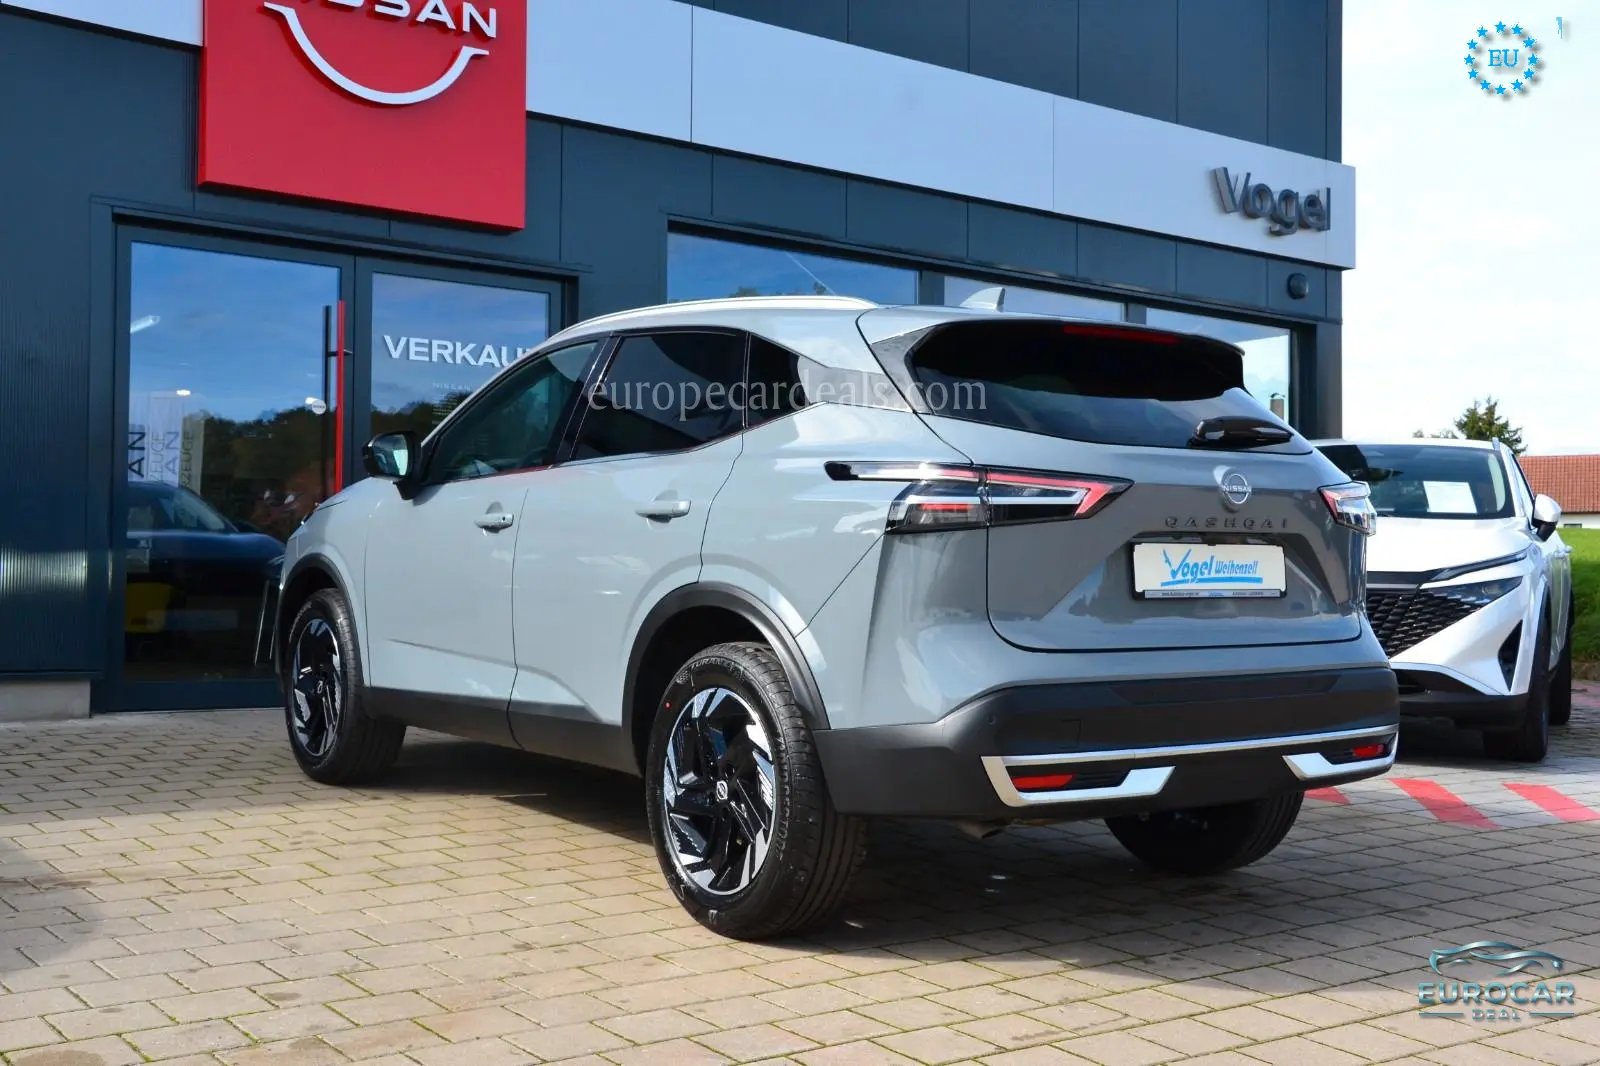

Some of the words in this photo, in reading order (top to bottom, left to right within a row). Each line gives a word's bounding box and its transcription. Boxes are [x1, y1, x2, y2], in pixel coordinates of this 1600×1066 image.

[327, 0, 497, 38] SAN
[1211, 166, 1331, 236] Vogel
[383, 335, 532, 369] VERKAU
[1221, 484, 1252, 493] NISSAN
[1165, 516, 1288, 529] QASHQAI
[1162, 548, 1215, 583] Vogel
